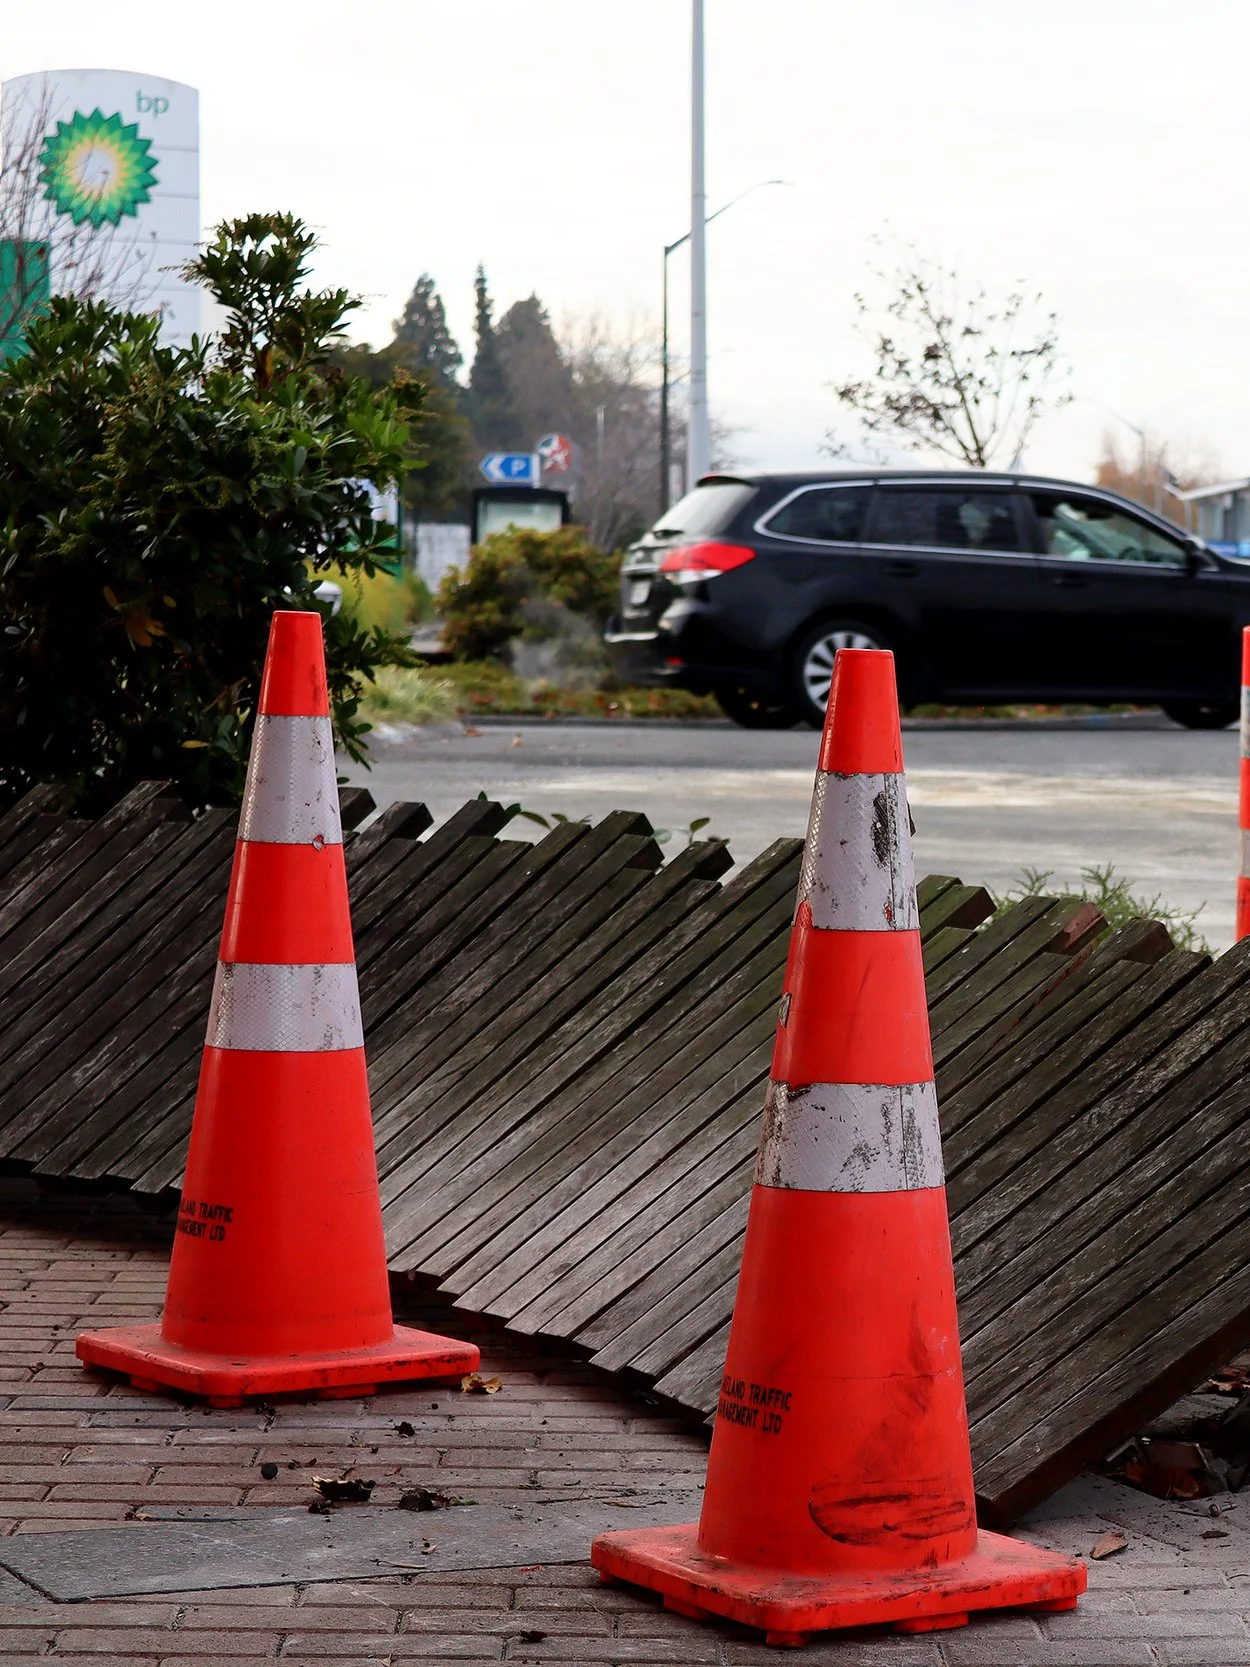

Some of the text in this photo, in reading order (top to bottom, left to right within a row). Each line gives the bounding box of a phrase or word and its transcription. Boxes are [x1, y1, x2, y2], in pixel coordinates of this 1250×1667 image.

[135, 90, 169, 119] bp
[511, 459, 527, 476] P
[200, 1202, 234, 1223] TRAFFIC
[209, 1223, 225, 1241] LTD
[750, 1382, 792, 1411] TRAFFIC
[762, 1412, 782, 1433] LTD
